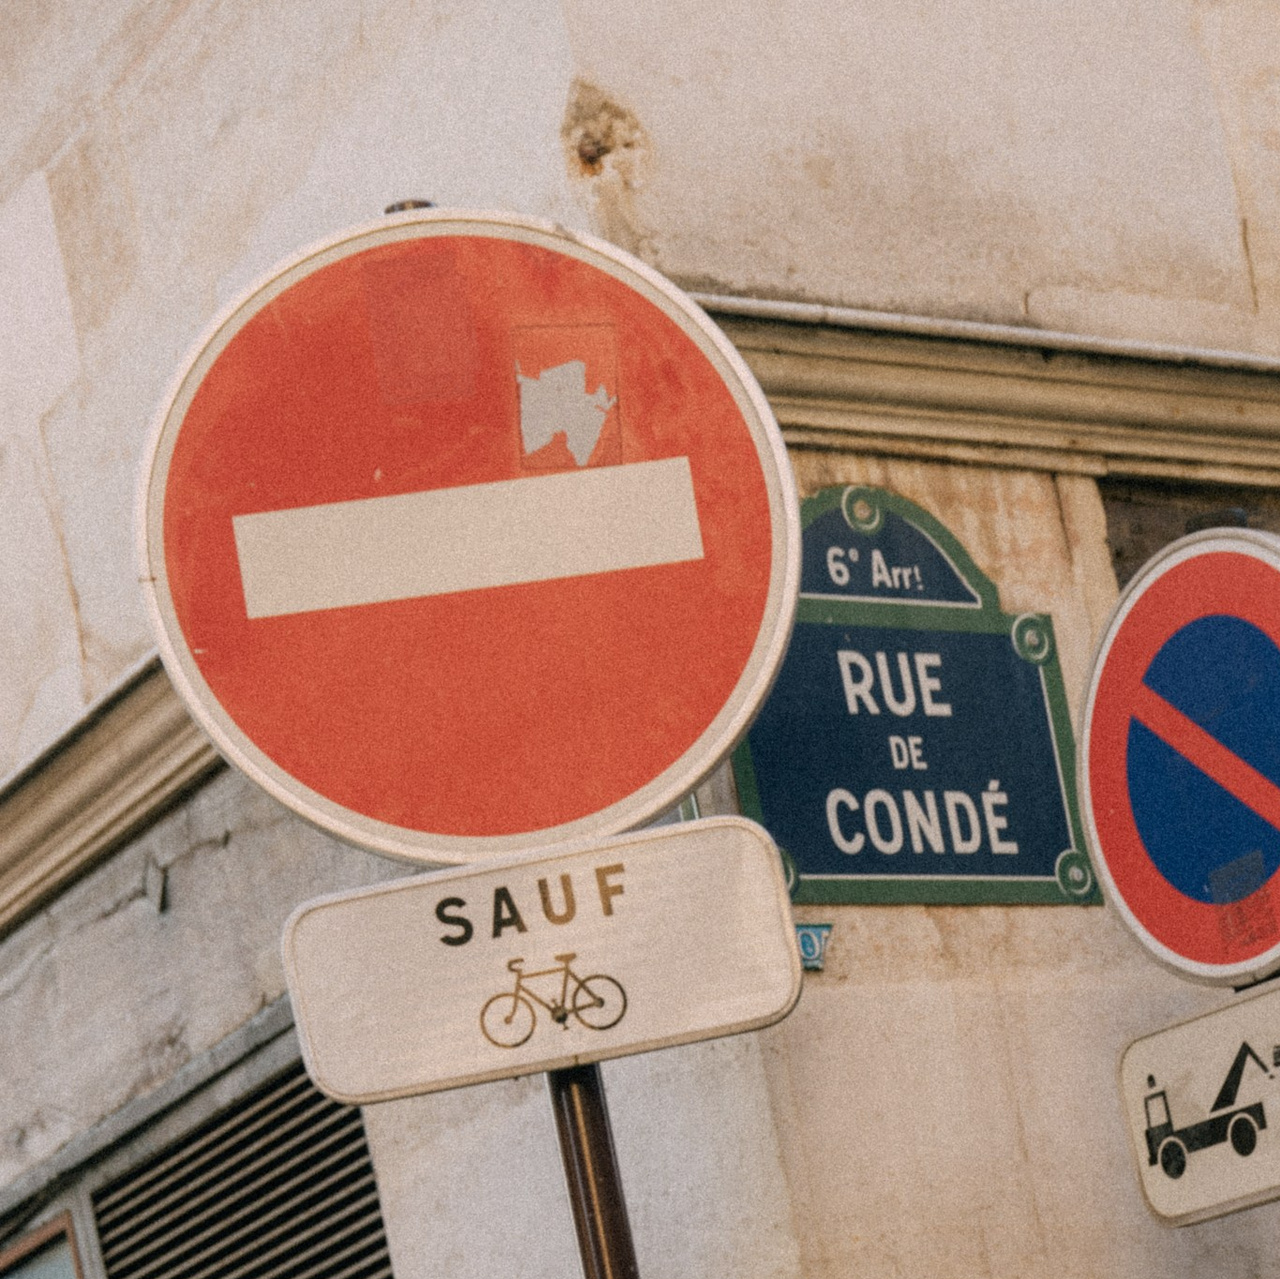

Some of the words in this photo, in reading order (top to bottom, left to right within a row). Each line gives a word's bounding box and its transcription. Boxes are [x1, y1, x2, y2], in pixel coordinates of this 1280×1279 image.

[837, 649, 952, 717] RUE
[889, 736, 928, 770] DE
[826, 780, 1019, 856] CONDÉ
[434, 863, 626, 947] SAUF
